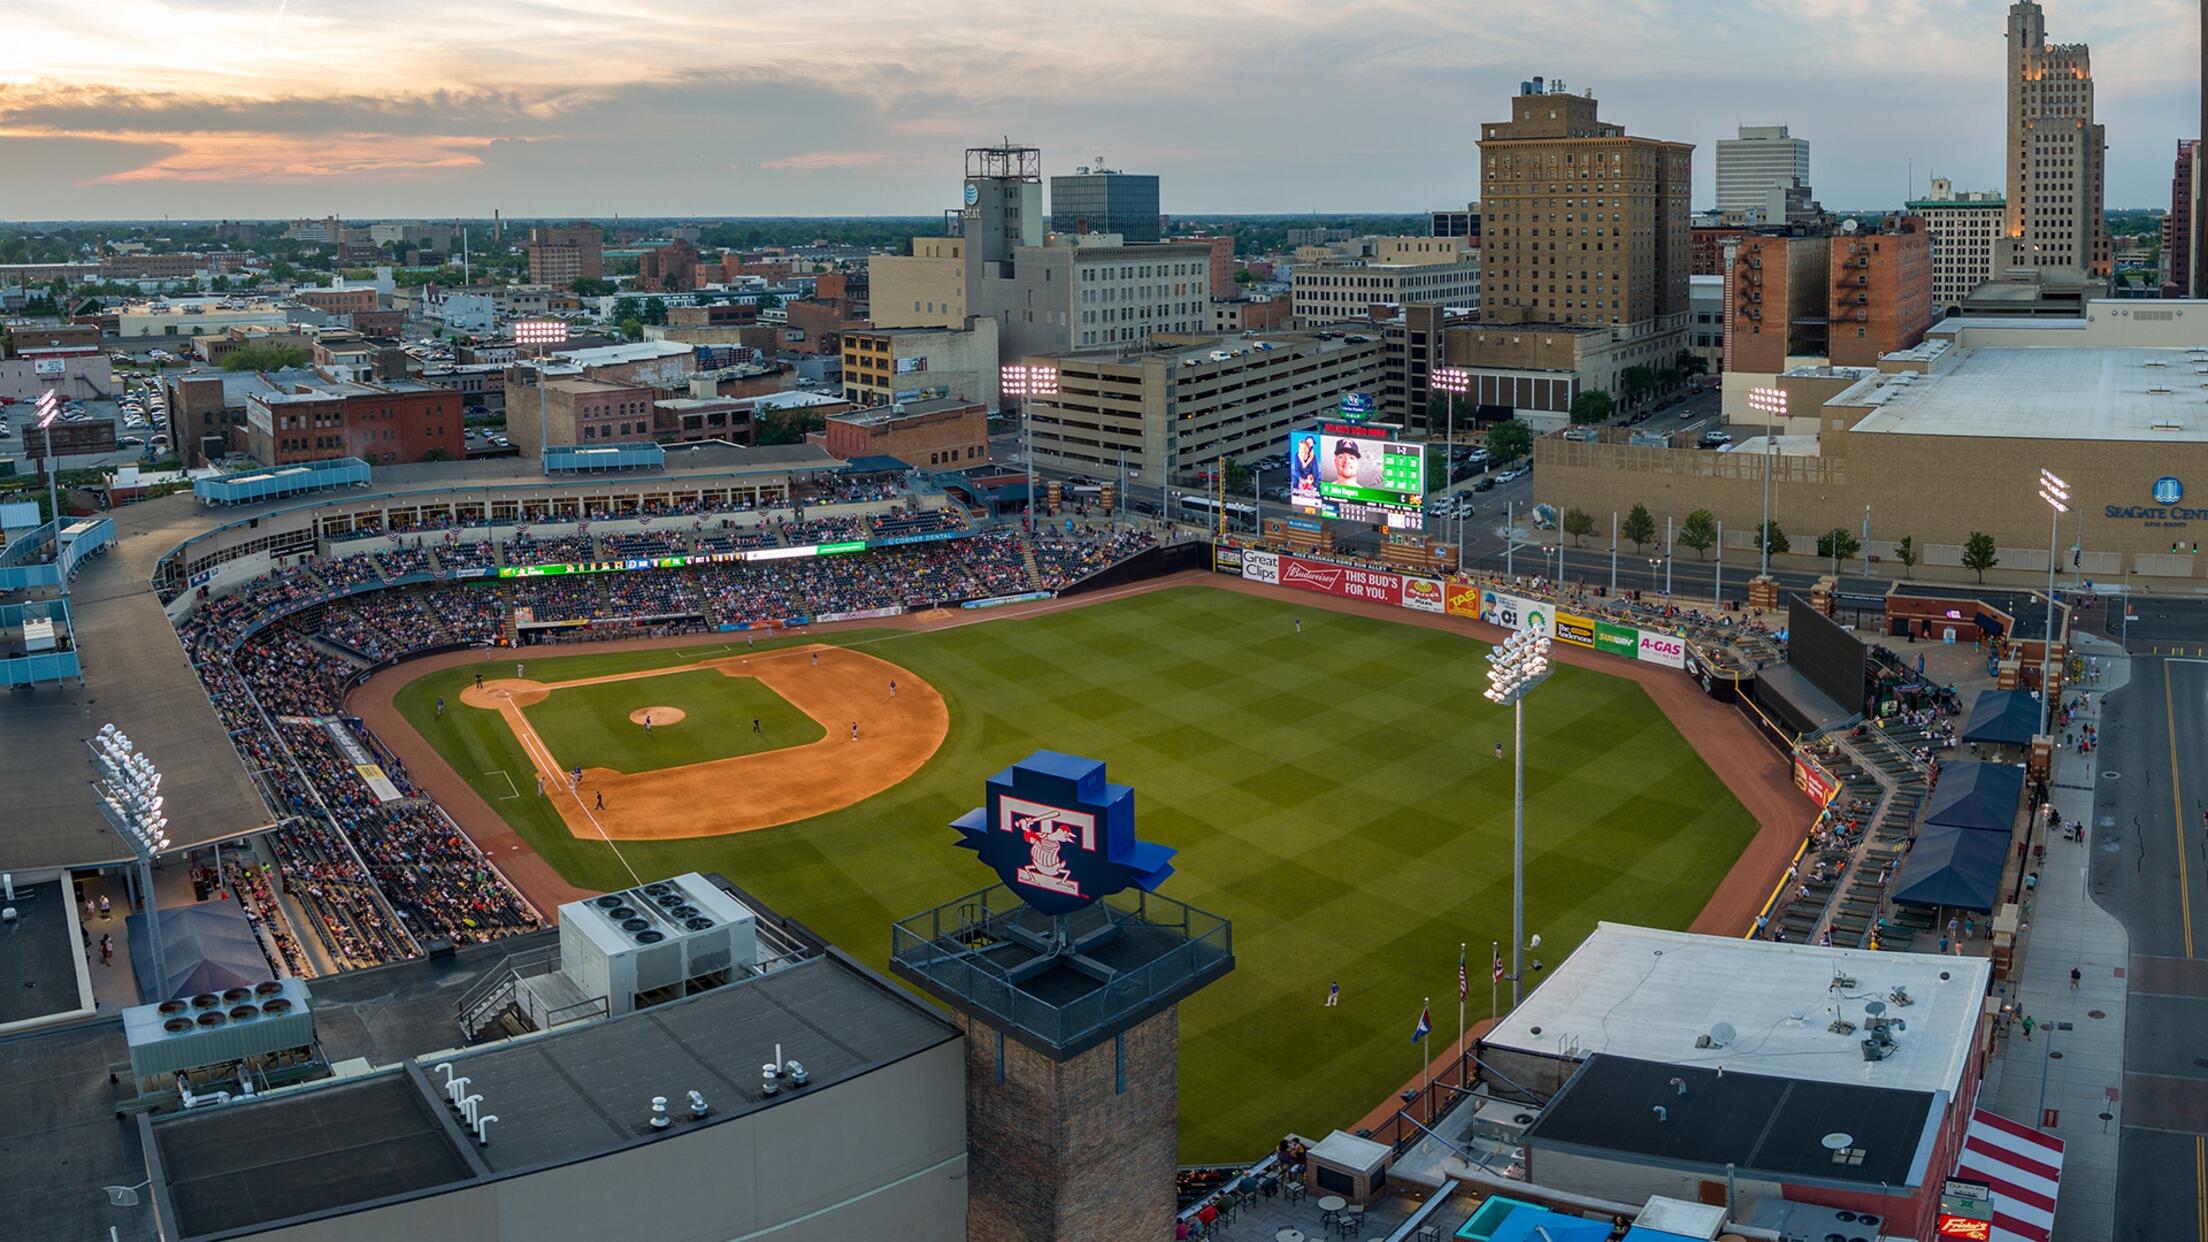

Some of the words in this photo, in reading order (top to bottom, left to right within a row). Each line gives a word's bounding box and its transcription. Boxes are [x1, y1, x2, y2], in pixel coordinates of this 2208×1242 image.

[895, 536, 923, 544] CORNER
[925, 533, 952, 541] DENTAL
[1243, 550, 1278, 567] Great
[1246, 564, 1276, 580] Clips
[1289, 565, 1335, 583] Budweiser
[1344, 569, 1367, 584] THIS
[1368, 574, 1398, 589] BUD'S
[1344, 583, 1364, 596] FOR
[1365, 587, 1388, 600] YOU.
[1450, 589, 1476, 607] TAS
[1558, 623, 1571, 631] The
[1558, 630, 1593, 644] Andersons
[1599, 632, 1634, 647] SUBWAY
[1640, 638, 1681, 655] A-GAS
